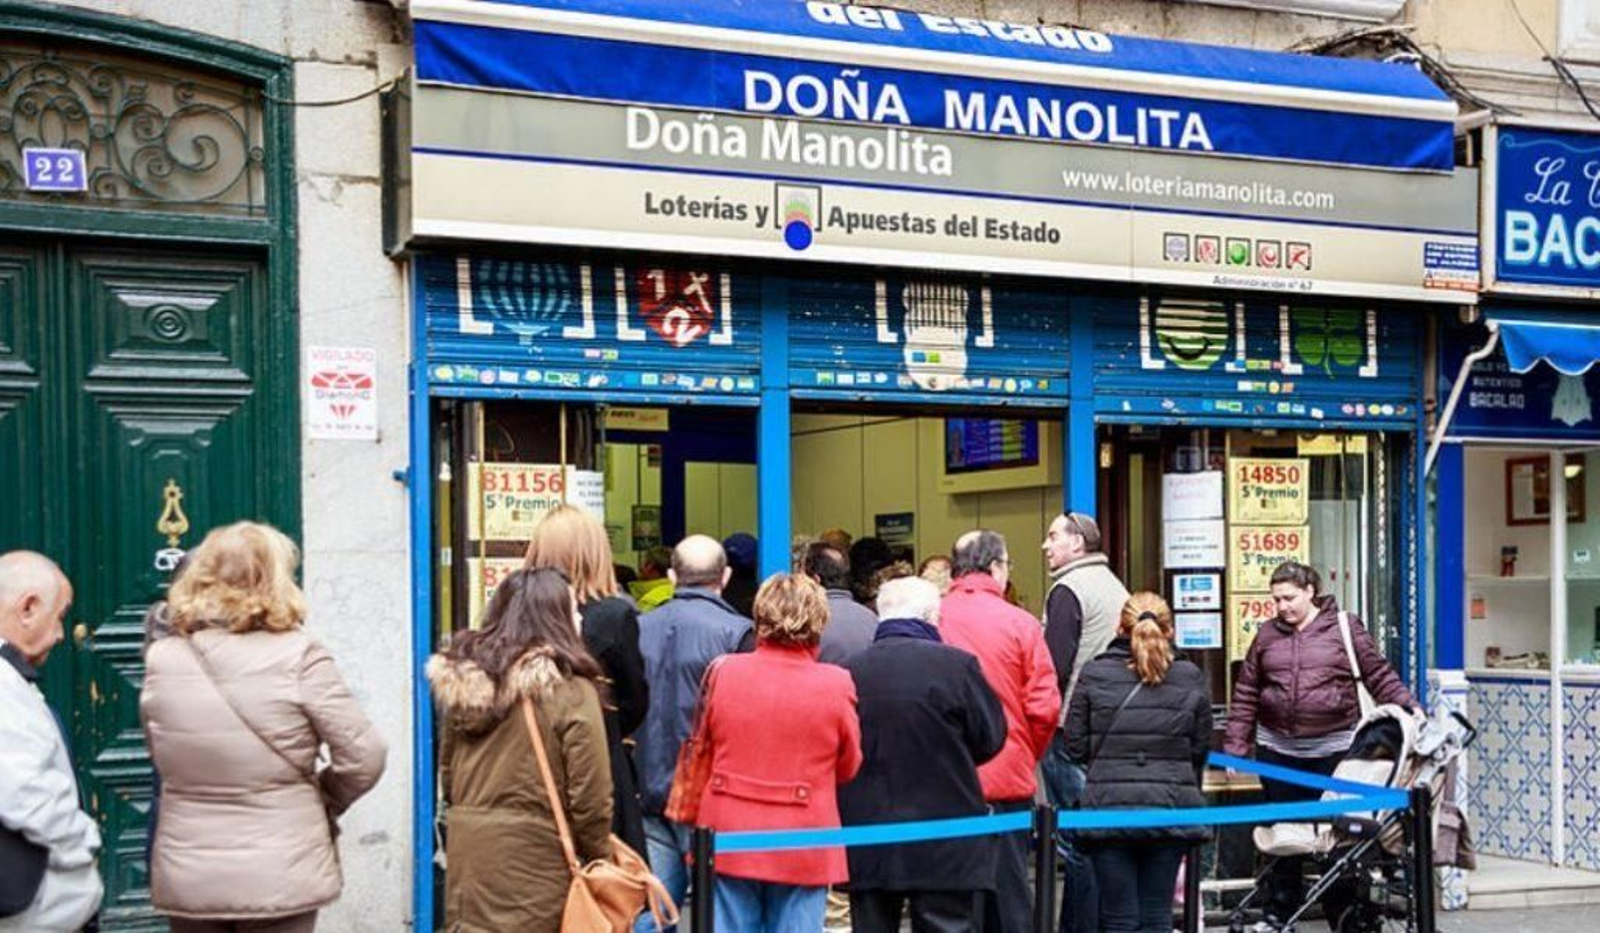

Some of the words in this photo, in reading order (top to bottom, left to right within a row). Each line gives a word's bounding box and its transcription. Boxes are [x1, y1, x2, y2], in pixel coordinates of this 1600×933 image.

[919, 13, 1113, 53] Estado
[743, 69, 910, 124] DOÑA
[944, 90, 1215, 150] MANOLITA
[626, 106, 747, 158] Doña
[760, 119, 953, 176] Manolita
[35, 157, 74, 182] 22
[1062, 169, 1335, 209] www.loteriamanolita.com
[1524, 157, 1572, 205] La
[645, 192, 747, 220] Loterías
[755, 204, 769, 228] y
[827, 206, 936, 234] Apuestas
[944, 214, 978, 238] del
[985, 218, 1061, 244] Estado
[482, 471, 564, 492] 81156
[1240, 466, 1300, 484] 14850
[1240, 533, 1300, 551] 51689
[1240, 600, 1274, 618] 798
